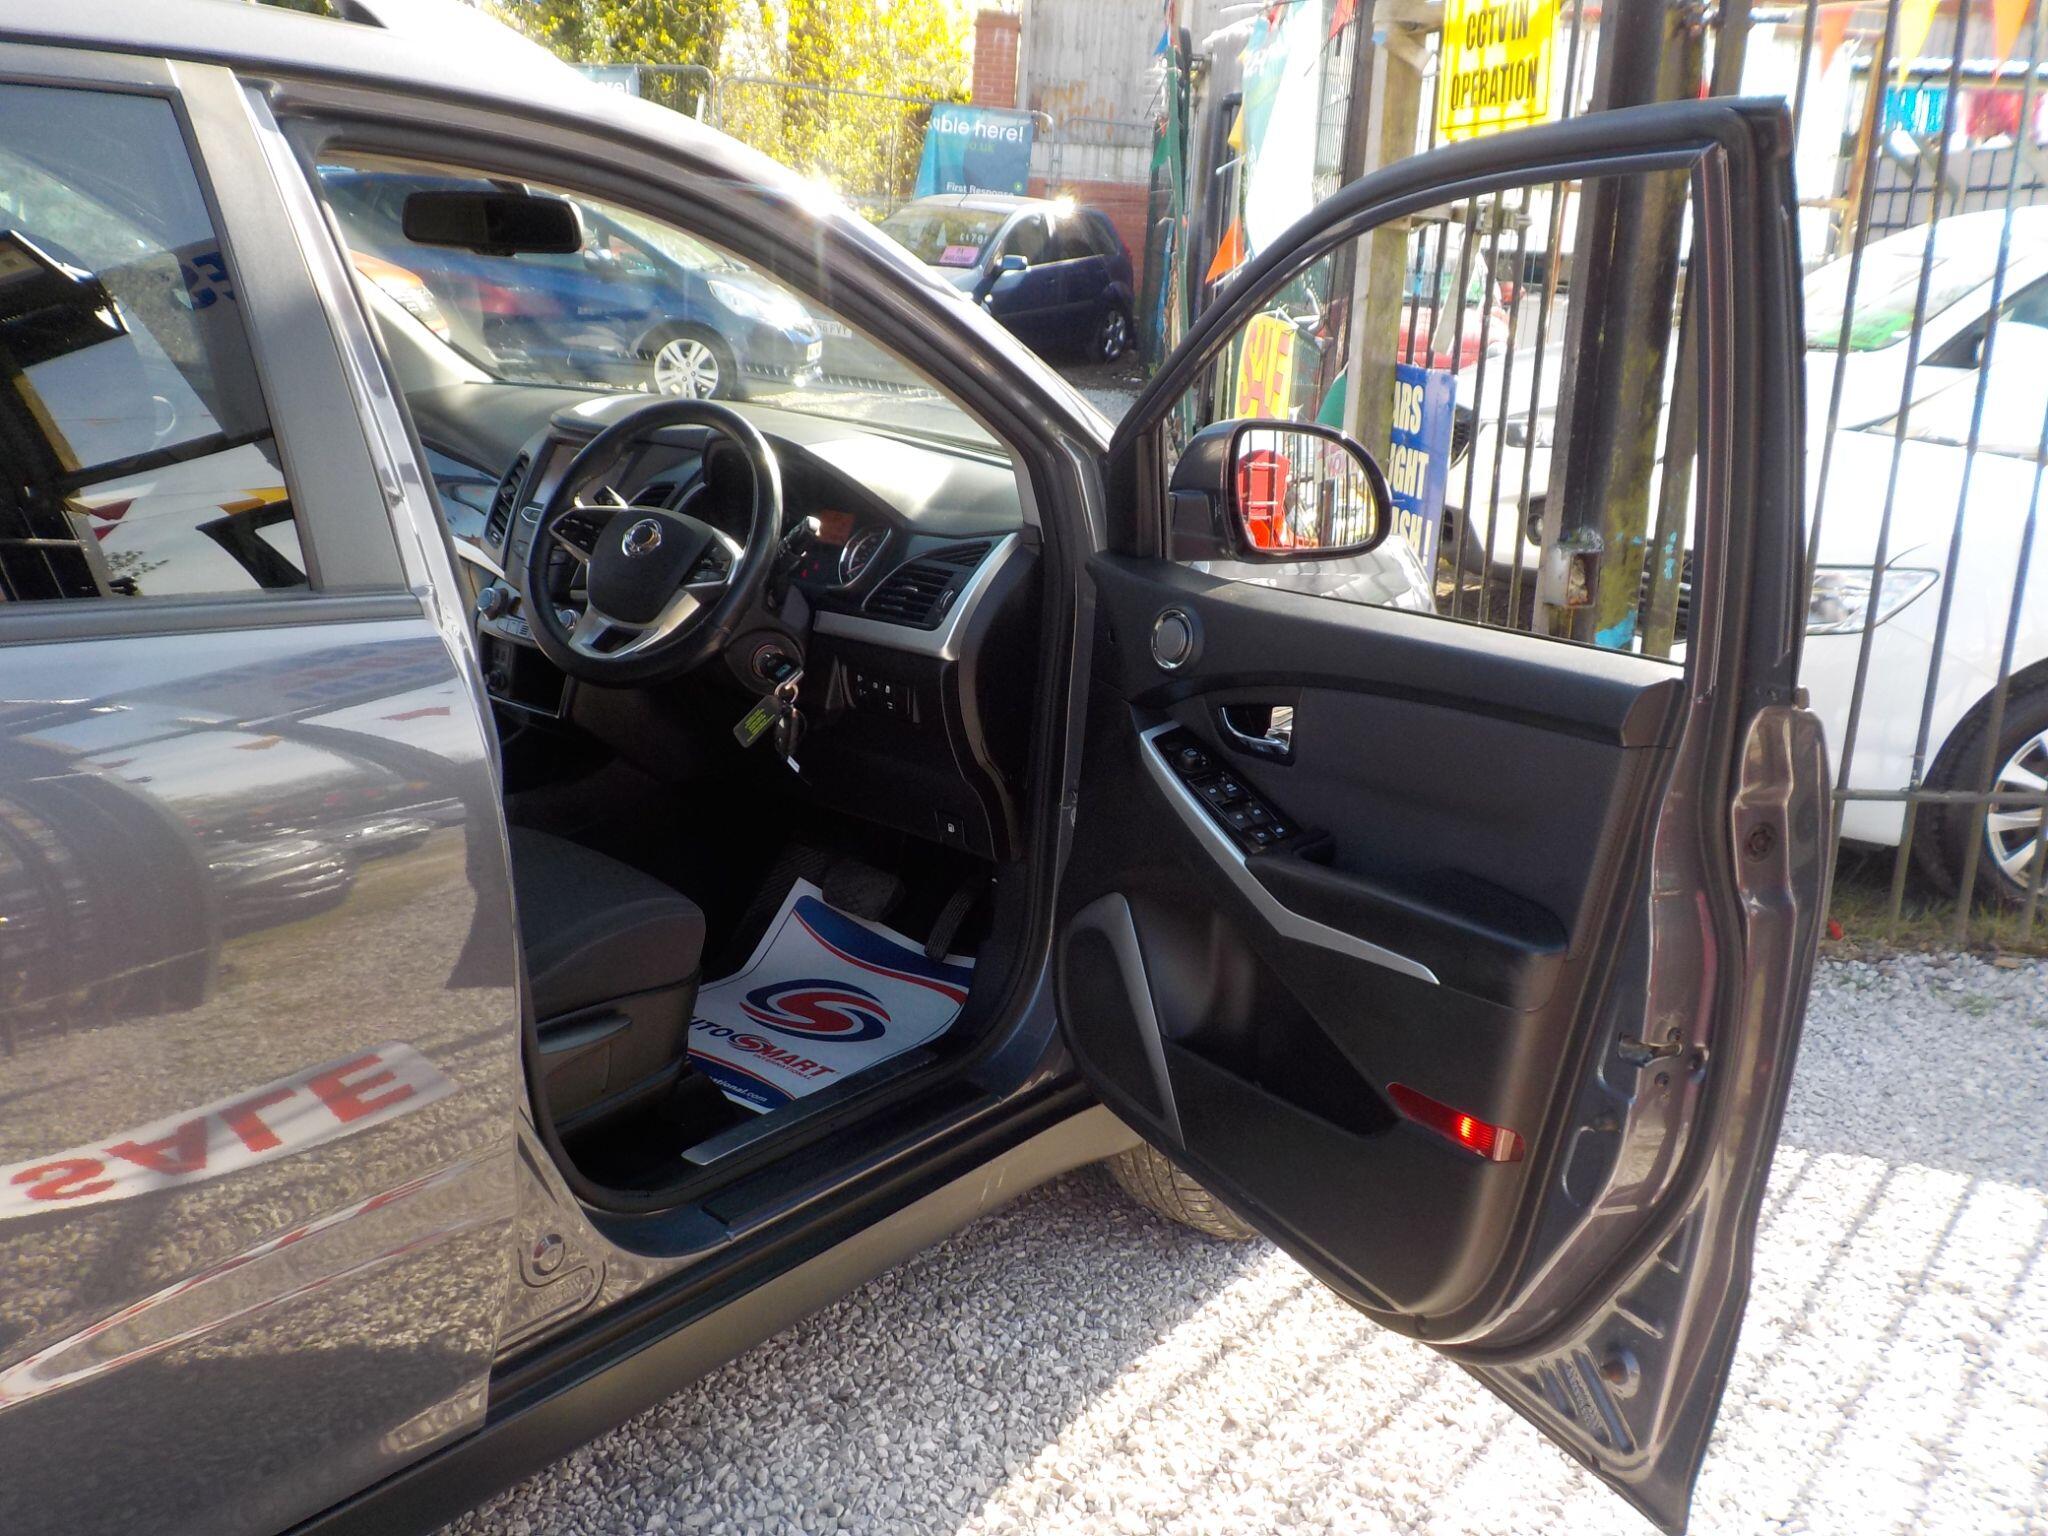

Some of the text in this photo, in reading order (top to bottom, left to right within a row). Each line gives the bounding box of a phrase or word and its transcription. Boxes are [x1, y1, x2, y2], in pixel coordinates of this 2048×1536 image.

[1466, 0, 1529, 51] CCTV IN
[1450, 56, 1539, 112] OPERATION
[974, 118, 1024, 143] here!
[946, 181, 968, 193] First
[1393, 381, 1424, 434] ARS
[1388, 443, 1429, 500] GHT
[689, 1015, 837, 1078] UTOSMART
[709, 1075, 768, 1103] ational.com
